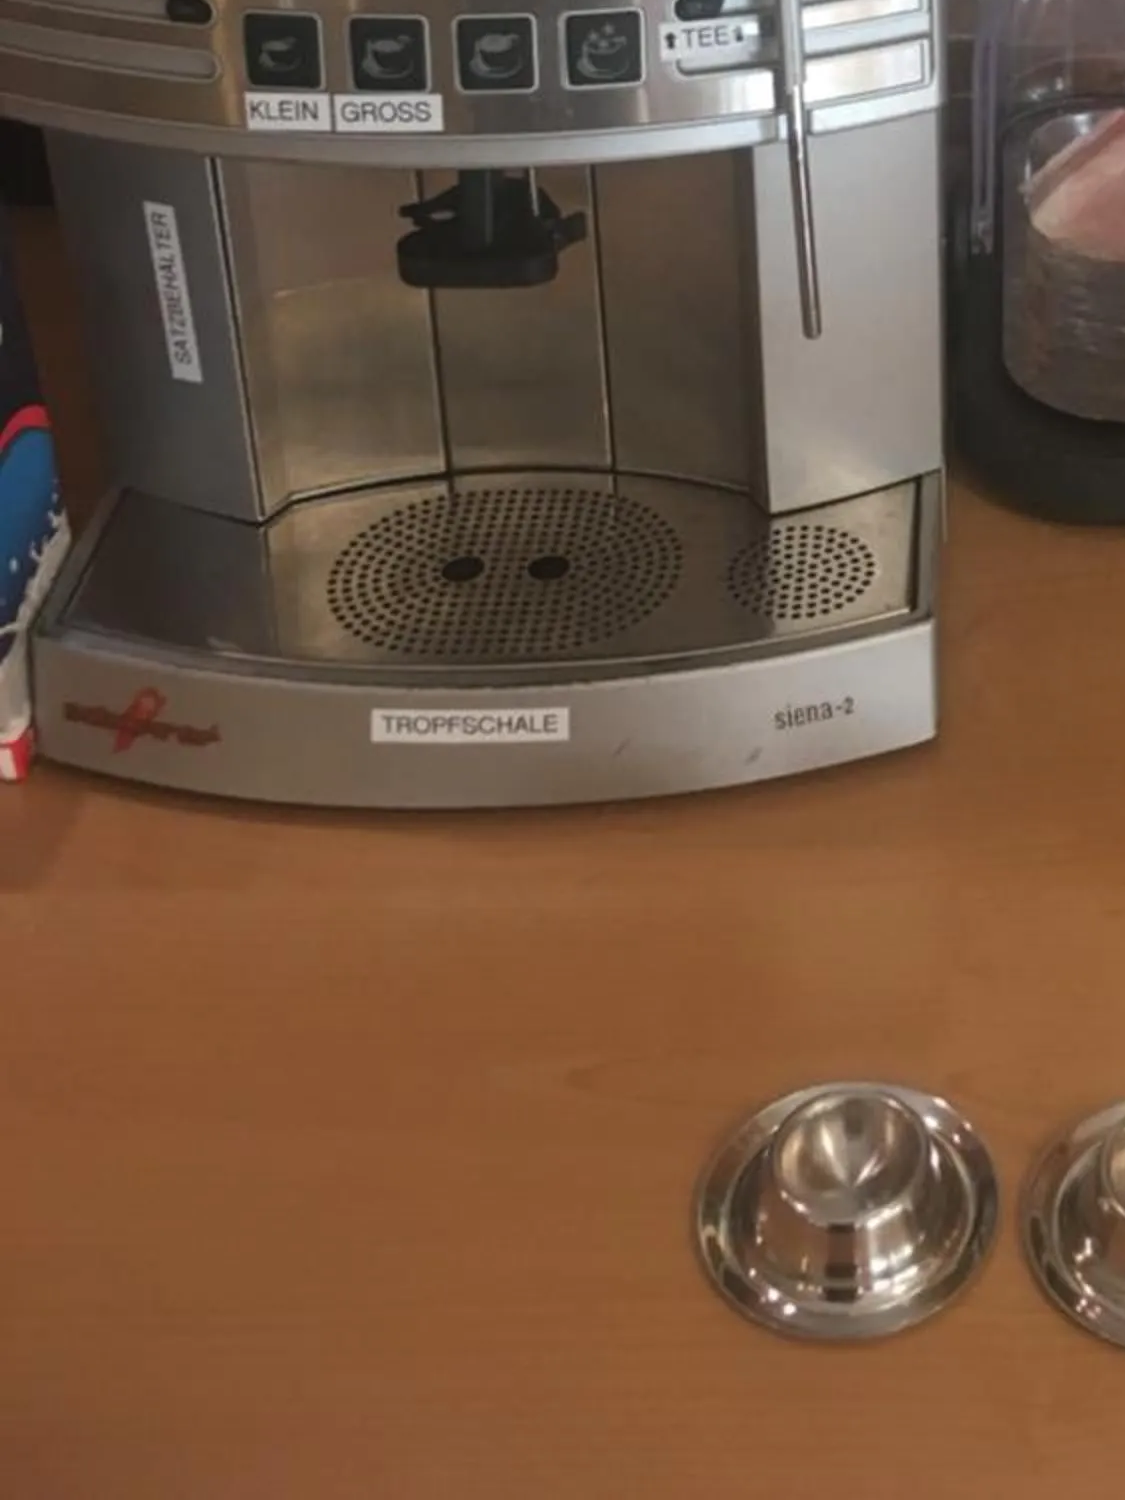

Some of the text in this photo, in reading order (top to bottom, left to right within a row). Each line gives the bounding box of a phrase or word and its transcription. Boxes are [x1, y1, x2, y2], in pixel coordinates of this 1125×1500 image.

[681, 25, 730, 49] TEE
[249, 100, 320, 122] KLEIN
[340, 101, 432, 123] GROSS
[377, 713, 560, 736] TROPFSCHALE
